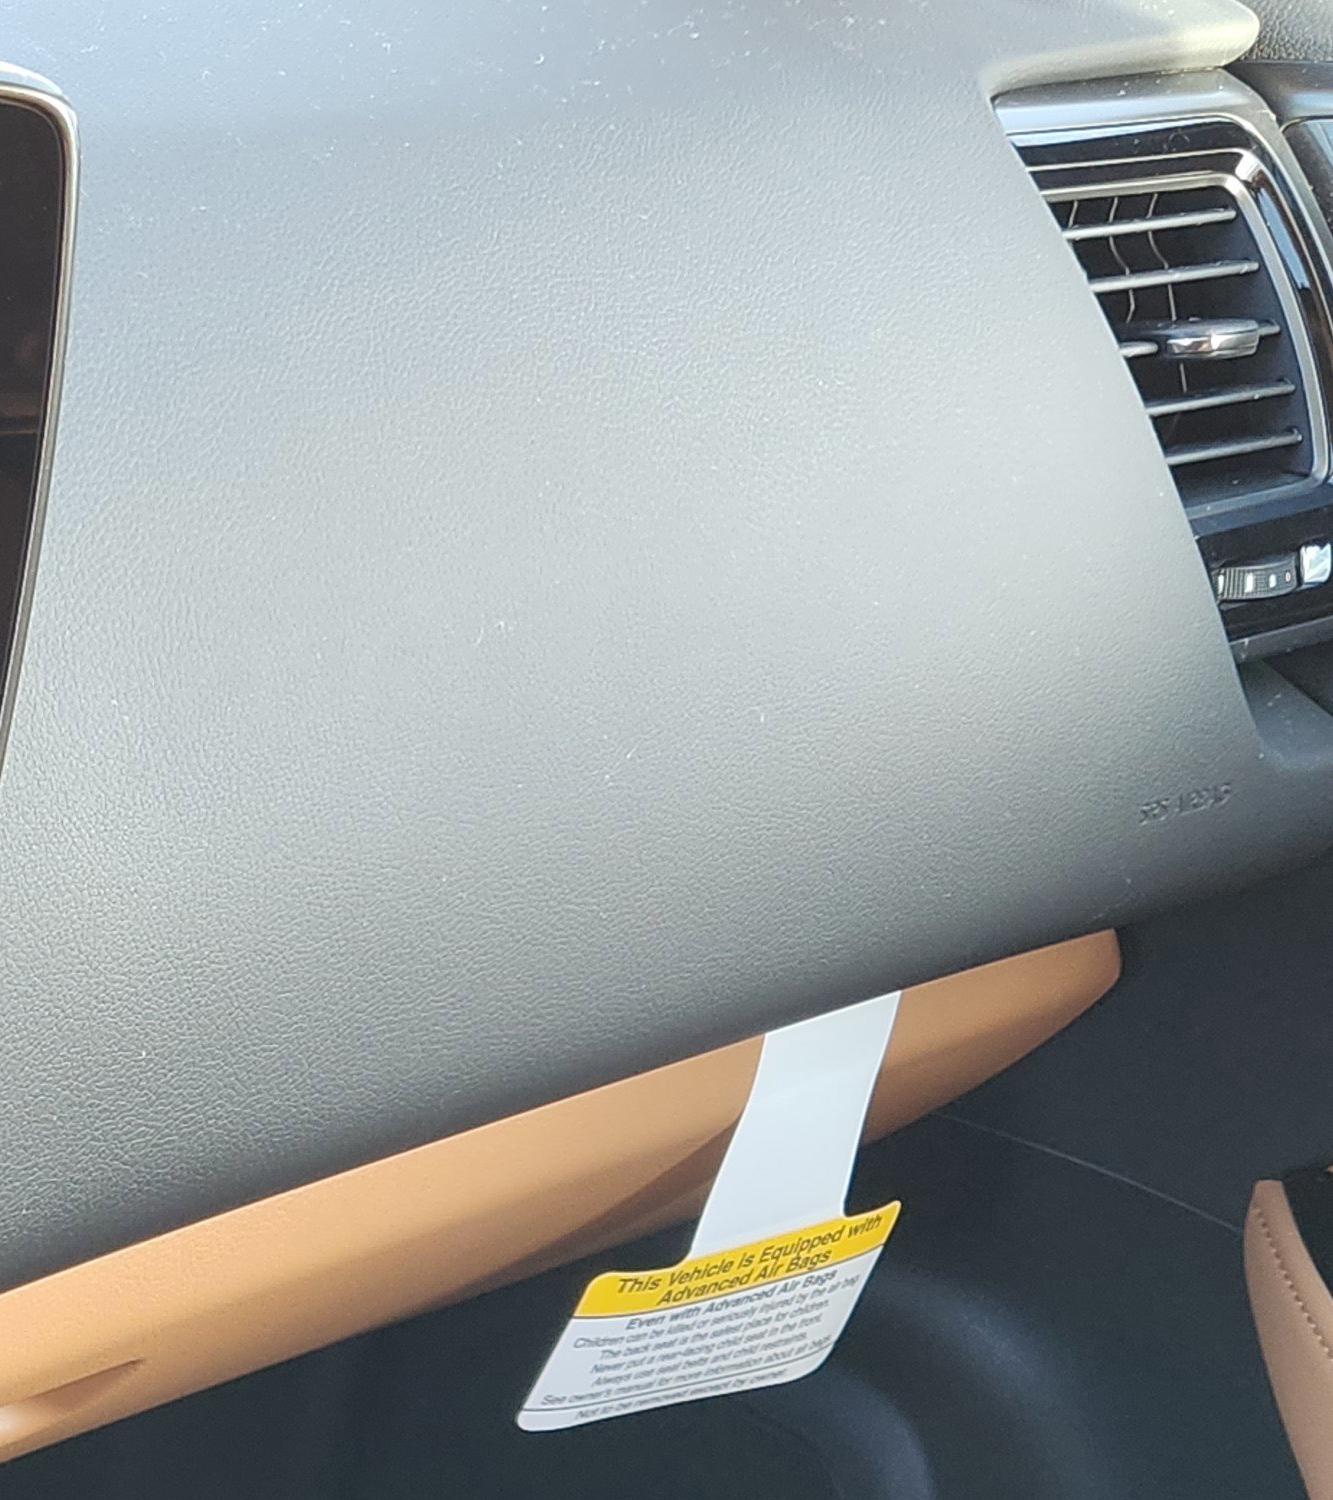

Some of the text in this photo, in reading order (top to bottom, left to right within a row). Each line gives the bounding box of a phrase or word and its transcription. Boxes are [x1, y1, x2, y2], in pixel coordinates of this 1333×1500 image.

[617, 1276, 663, 1294] This
[668, 1258, 735, 1286] Vehicle
[758, 1224, 846, 1266] Equipped
[846, 1214, 882, 1238] with
[655, 1249, 832, 1306] Advanced Air Bags
[625, 1269, 838, 1331] Even with Advanced Air Bags
